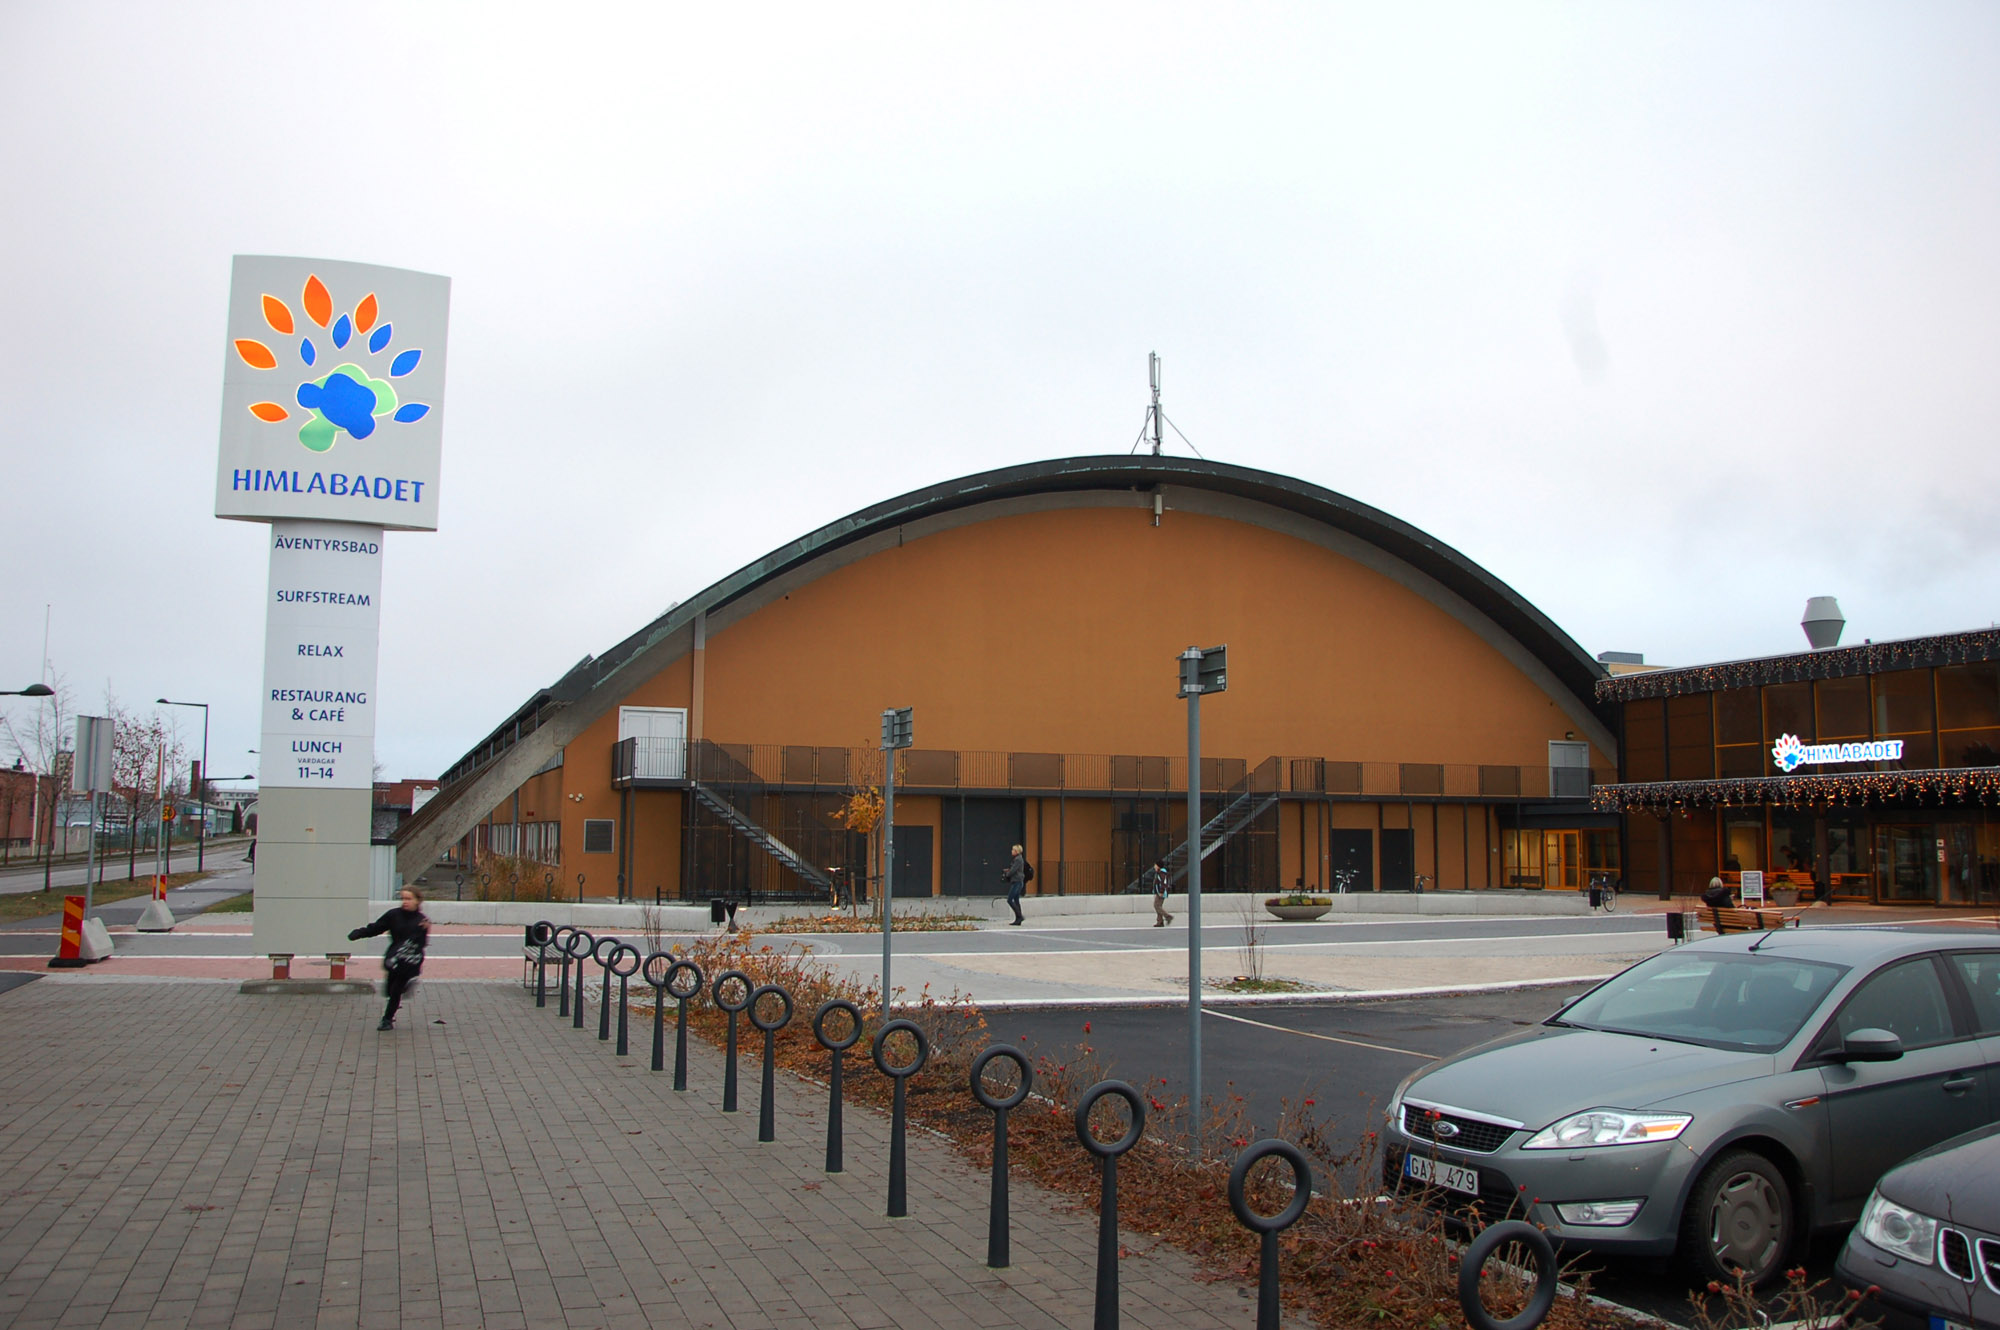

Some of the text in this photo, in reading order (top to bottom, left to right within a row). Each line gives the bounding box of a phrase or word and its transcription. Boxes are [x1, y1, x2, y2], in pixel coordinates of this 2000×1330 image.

[233, 469, 425, 503] HIMLABADET
[275, 534, 379, 555] ÄVENTYRSBAD
[276, 590, 371, 606] SURFSTREAM
[297, 644, 344, 658] RELAX
[271, 688, 367, 704] RESTAURANG
[291, 706, 345, 722] & CAFÉ
[292, 740, 342, 753] LUNCH
[1806, 742, 1902, 762] HIMLABADET
[297, 757, 336, 765] VARDAGAR
[1446, 1167, 1475, 1191] 479
